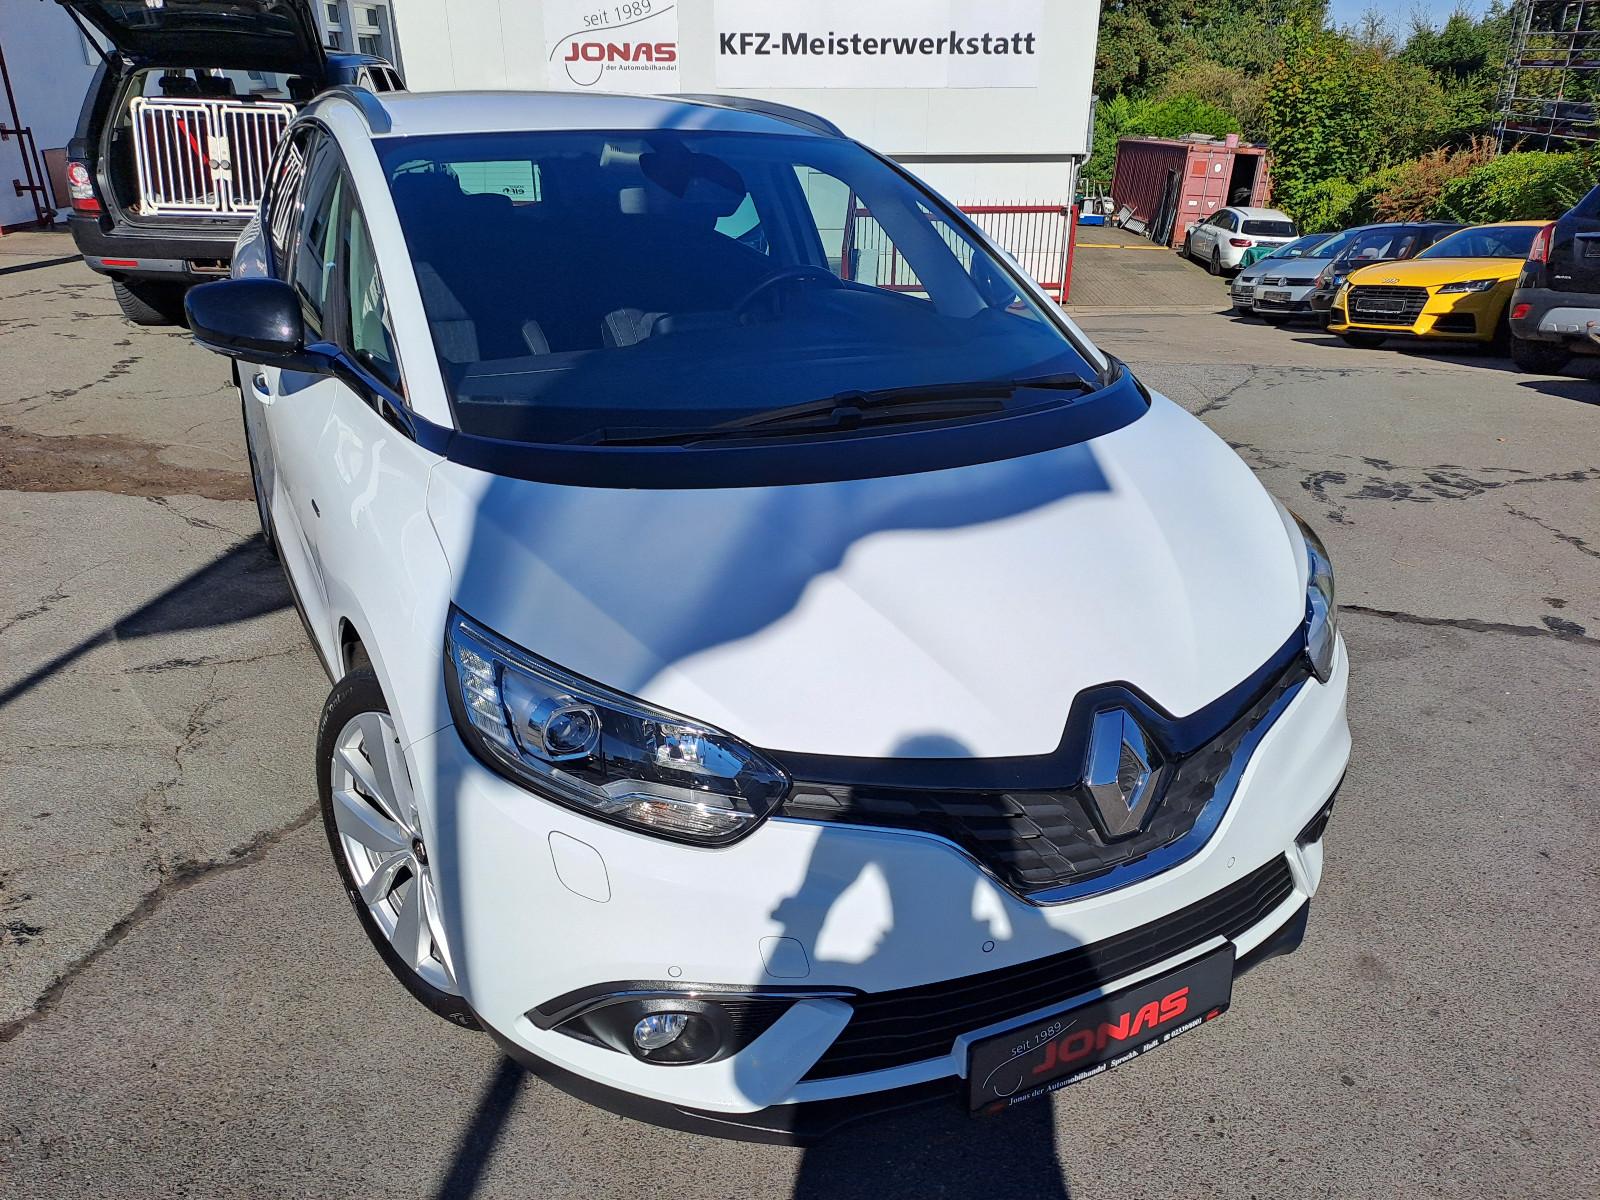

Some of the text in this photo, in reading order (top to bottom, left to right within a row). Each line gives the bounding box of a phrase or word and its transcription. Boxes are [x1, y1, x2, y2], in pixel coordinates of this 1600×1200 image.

[583, 0, 652, 27] seit 1989
[565, 42, 676, 62] JONAS
[719, 31, 1035, 55] KFZ-Meisterwerkstatt
[1011, 1021, 1062, 1056] seit 1989
[1032, 986, 1189, 1075] JONAS
[1009, 1093, 1031, 1106] Jonas
[1031, 1087, 1045, 1099] der
[1045, 1063, 1107, 1093] Automobilhandel
